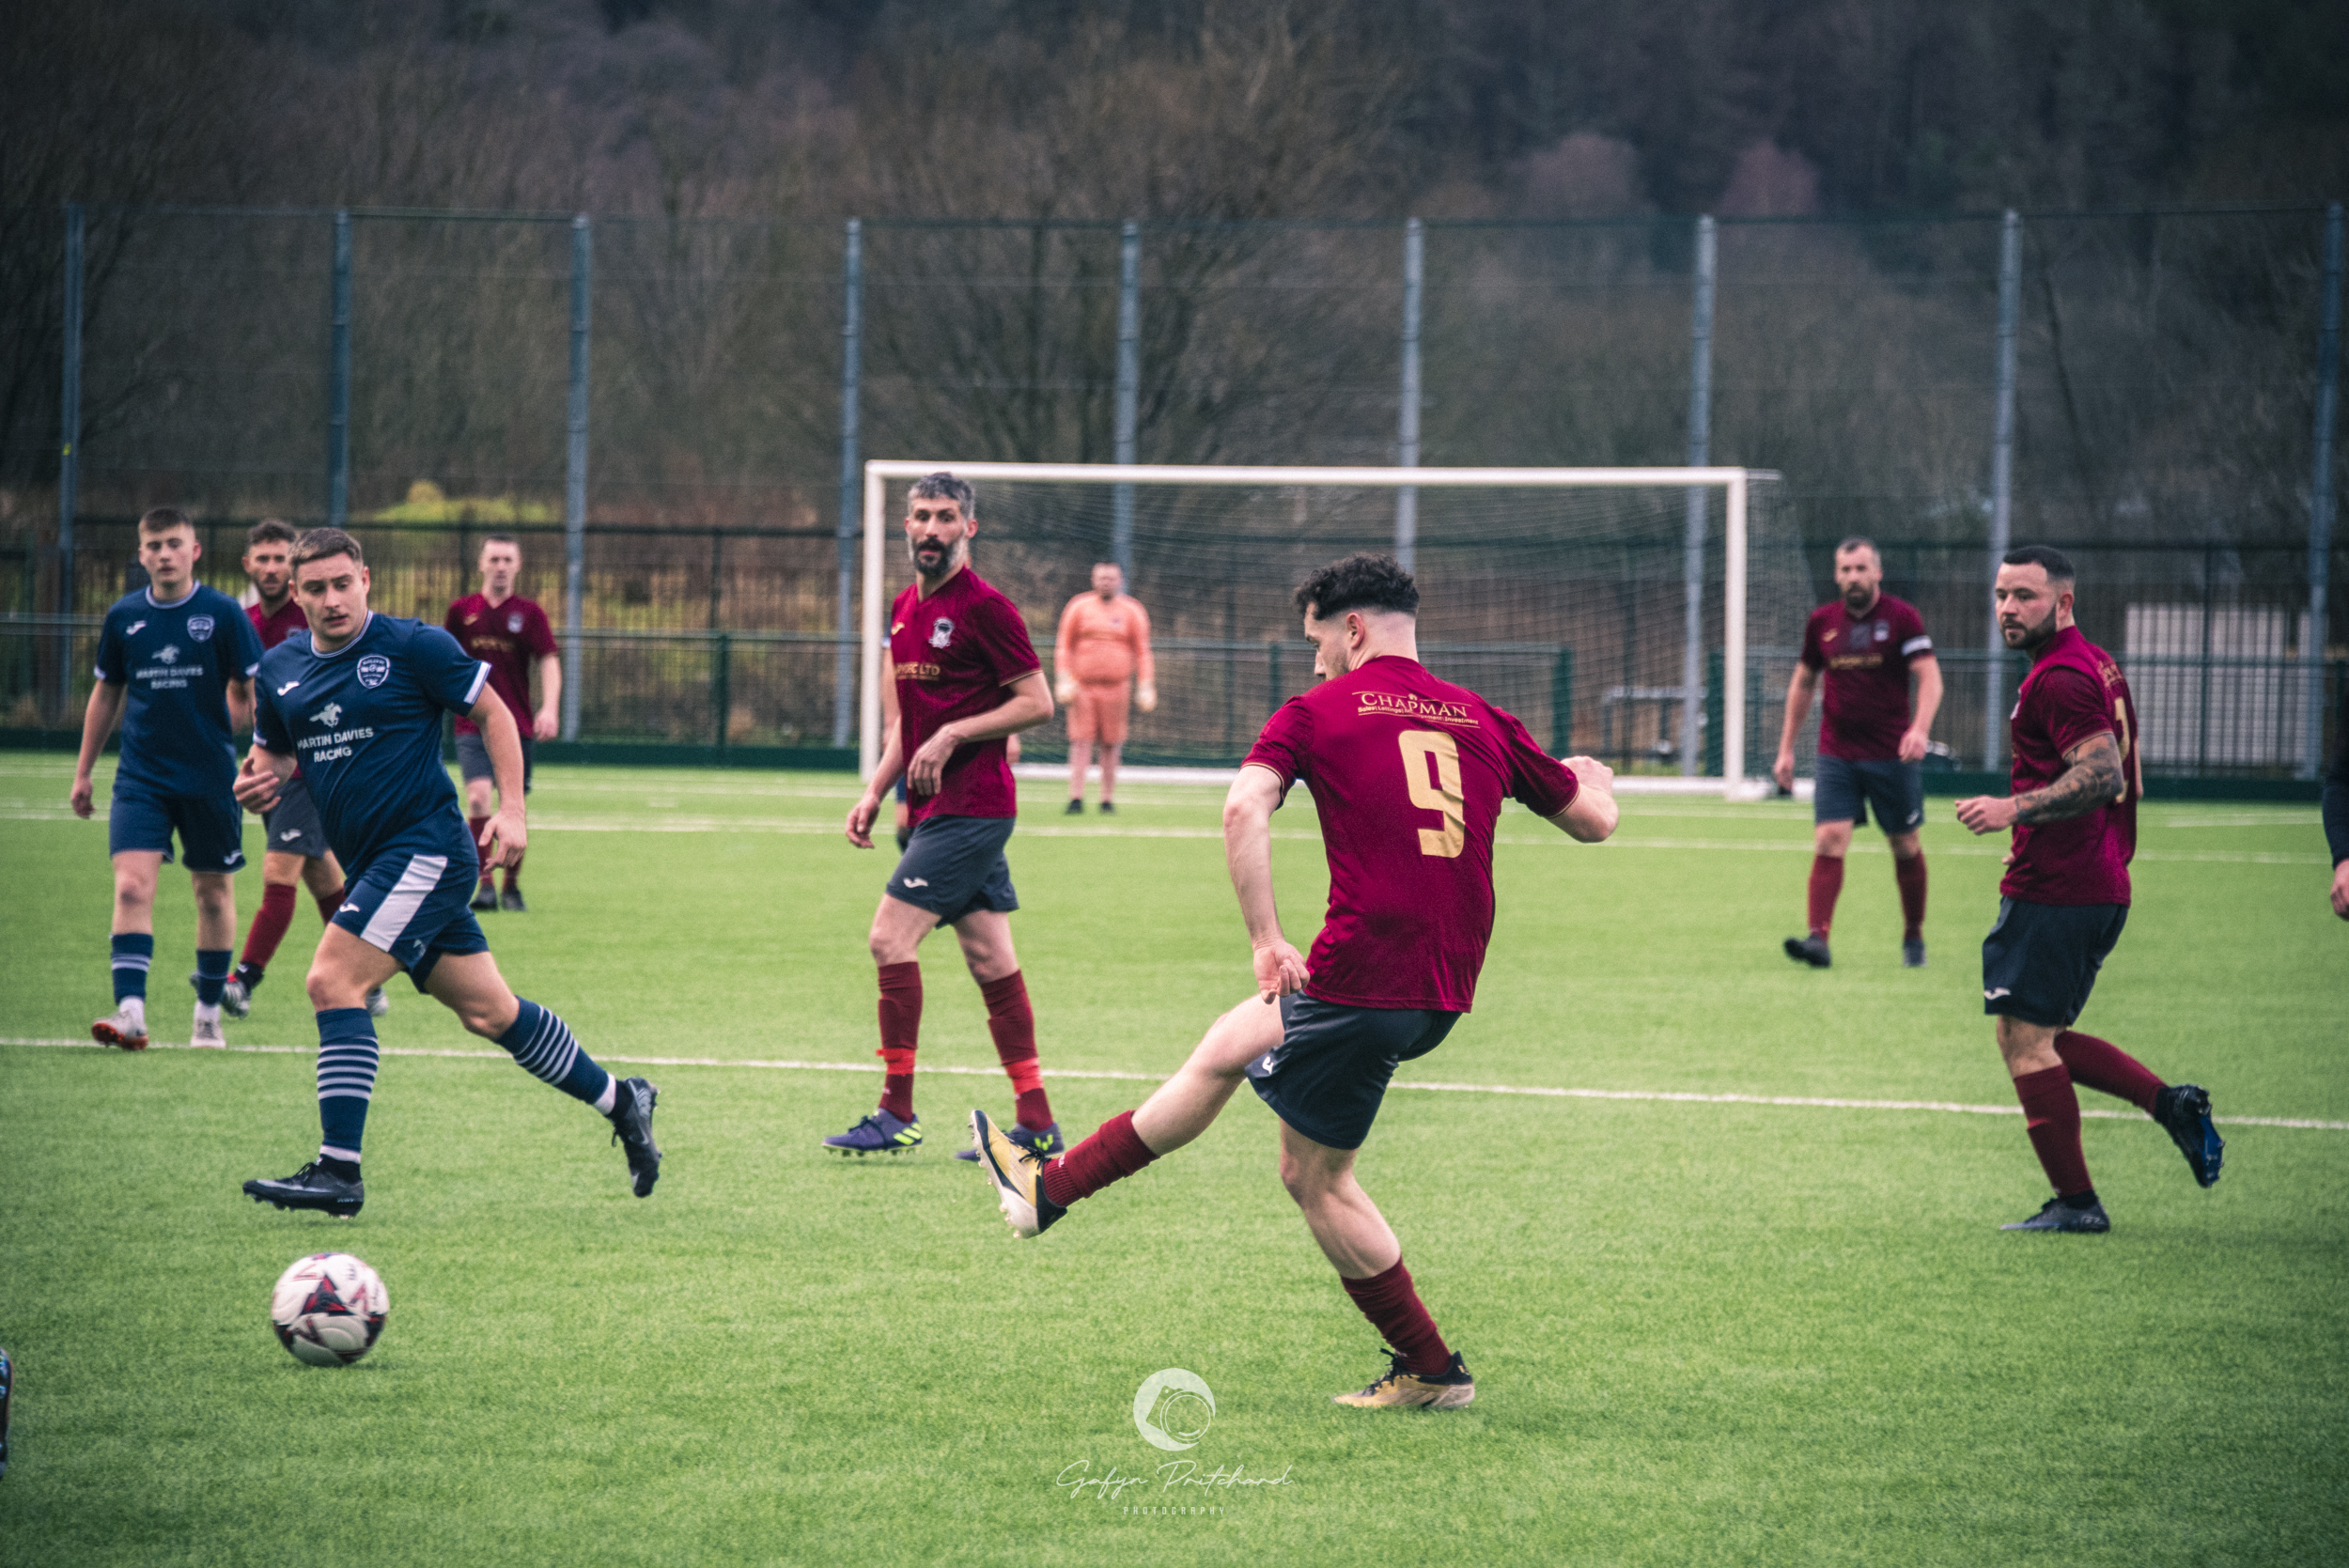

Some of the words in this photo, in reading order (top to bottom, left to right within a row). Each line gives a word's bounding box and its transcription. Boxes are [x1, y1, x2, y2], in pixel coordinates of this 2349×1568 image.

[1361, 693, 1468, 717] CHAPMAN
[297, 734, 333, 750] MARTIN
[334, 727, 374, 744] DAVIES
[313, 746, 352, 763] RACING
[1398, 730, 1466, 859] 9
